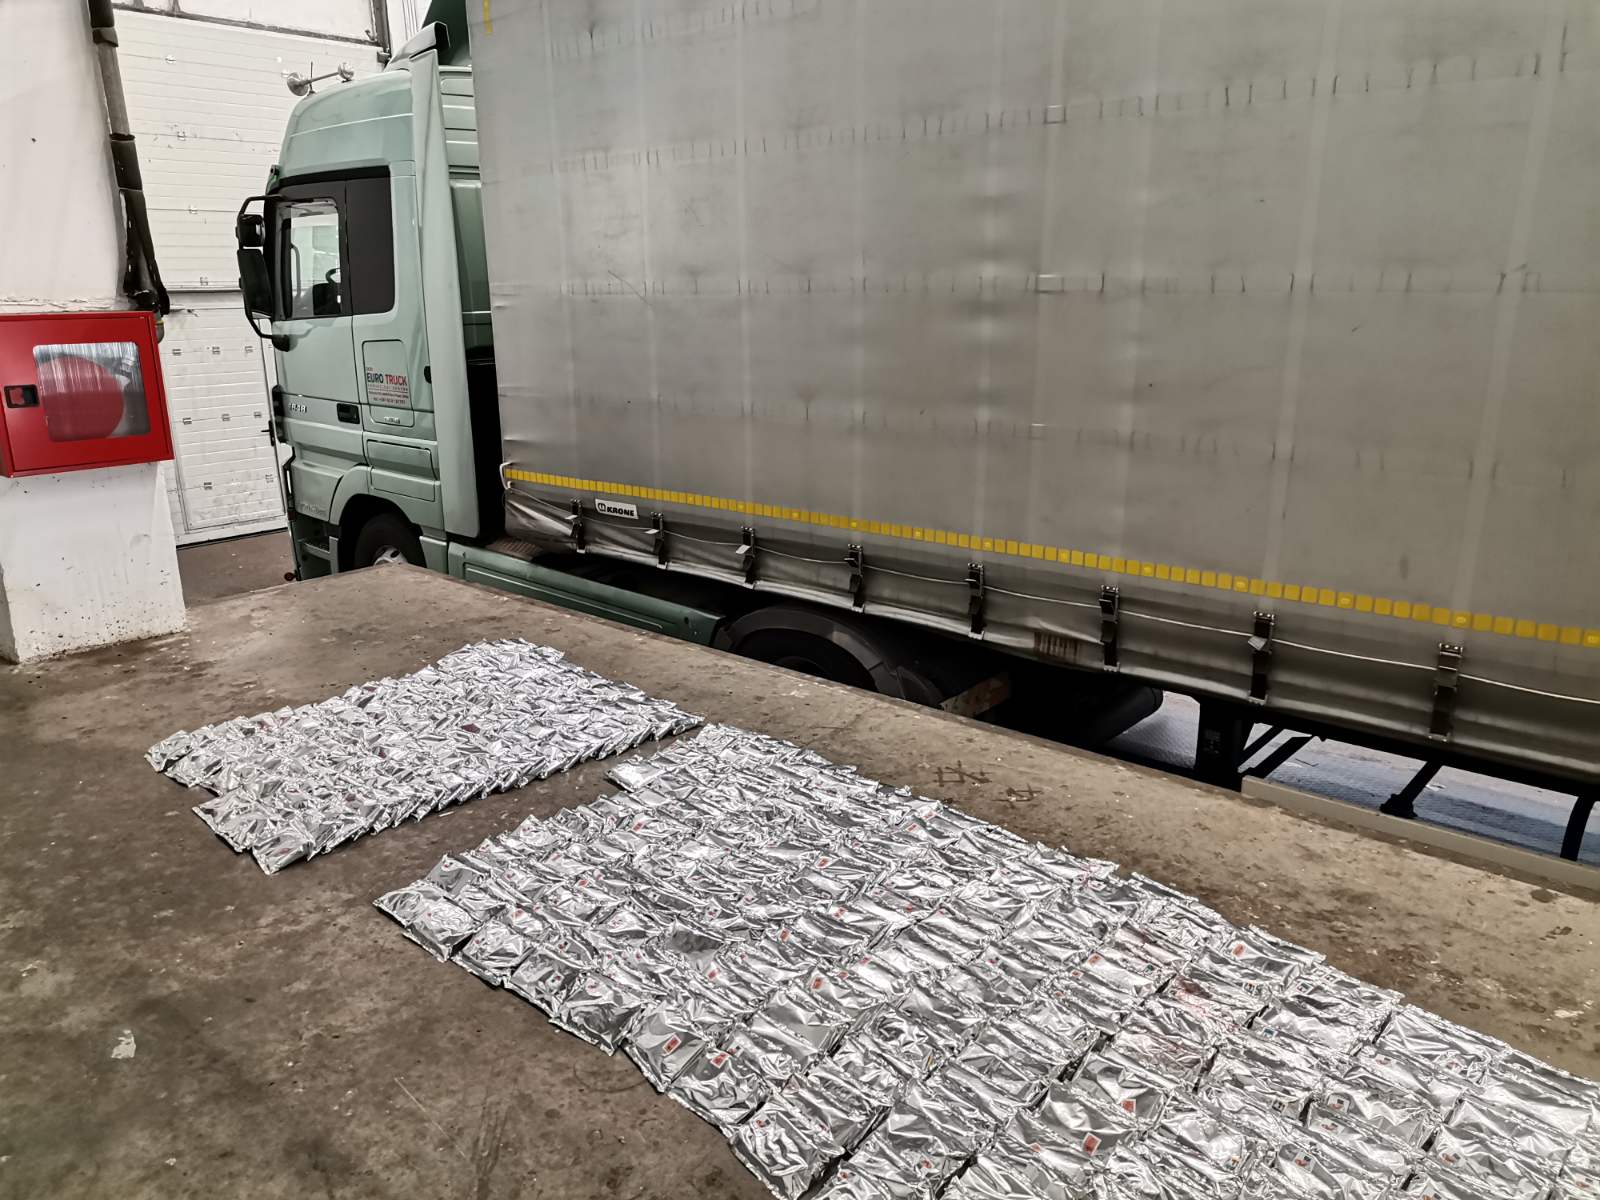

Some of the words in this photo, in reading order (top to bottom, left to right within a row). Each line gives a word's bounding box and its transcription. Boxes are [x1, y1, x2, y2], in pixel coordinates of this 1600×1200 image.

[367, 372, 384, 383] EURO
[385, 374, 407, 385] TRUCK
[606, 506, 635, 516] KRONE
